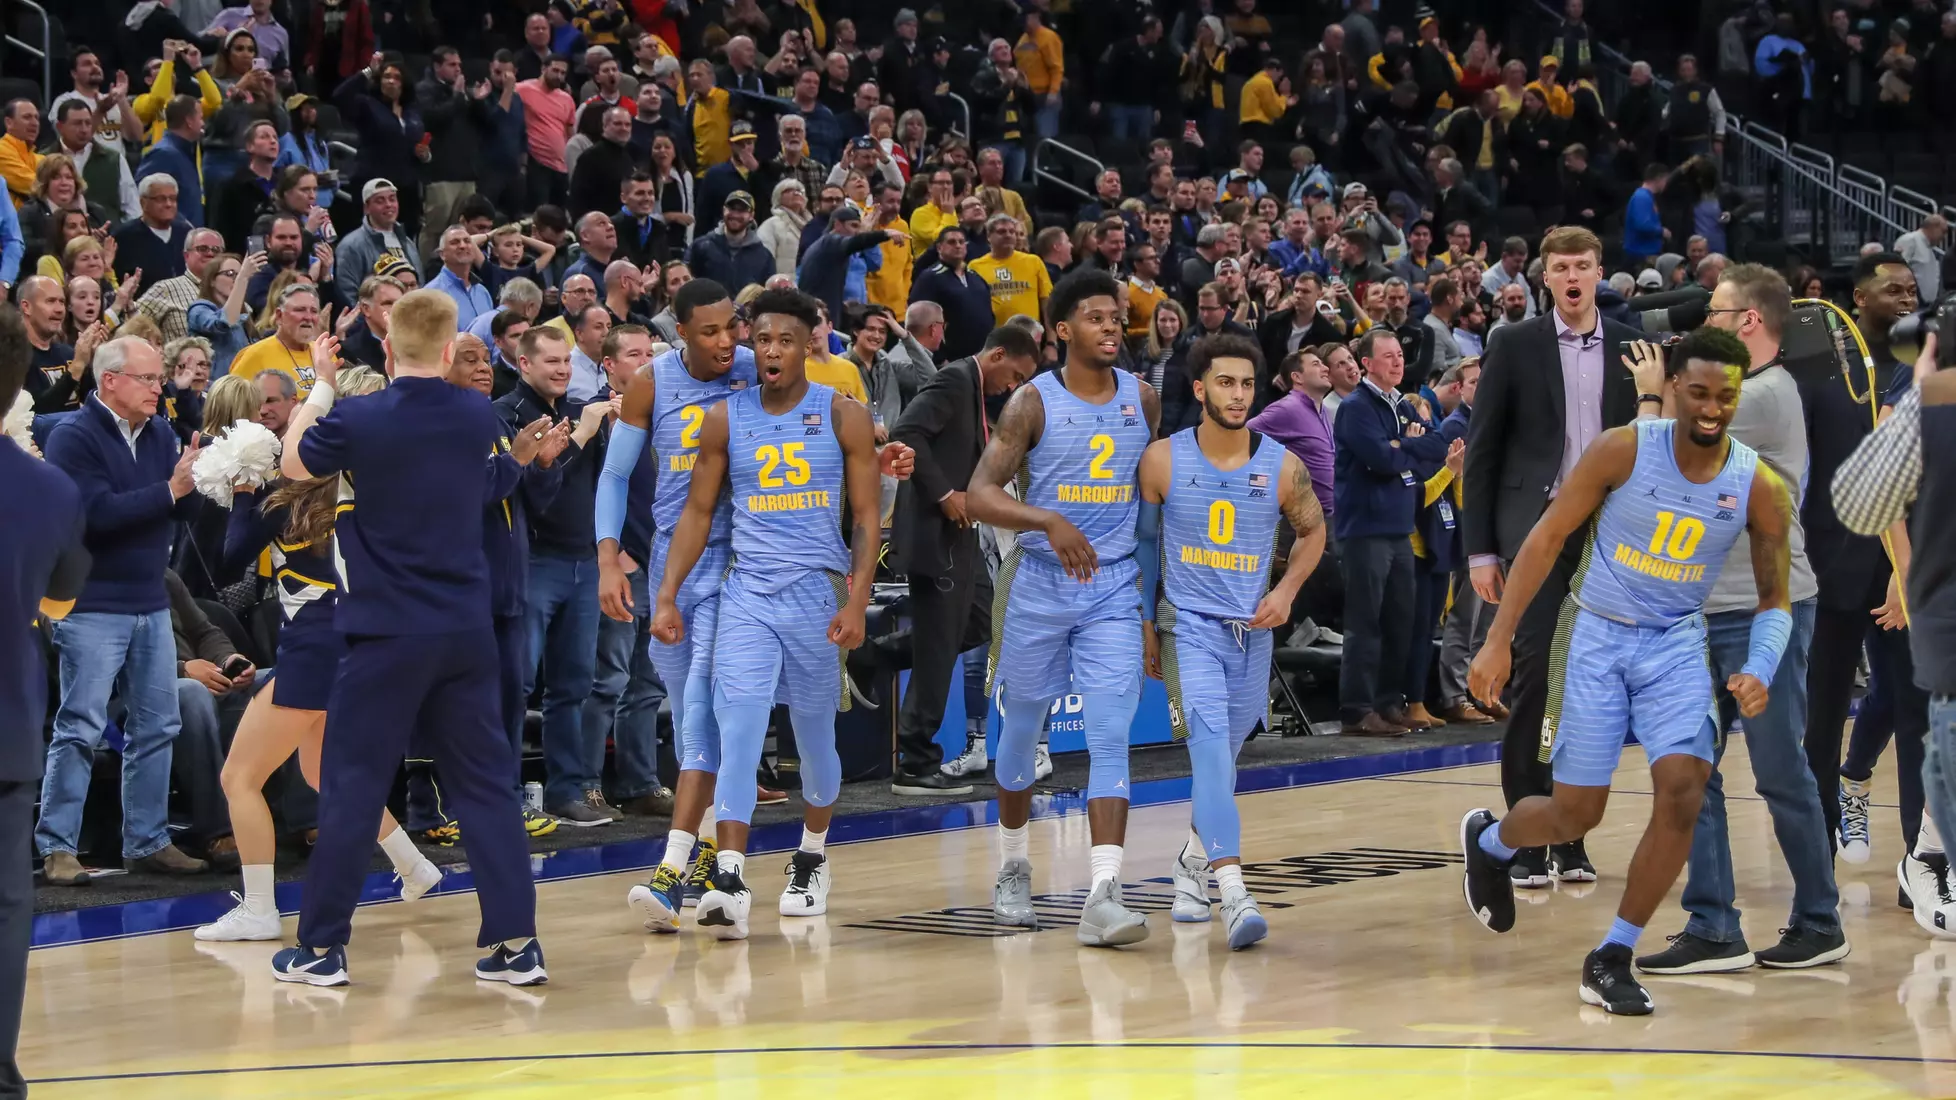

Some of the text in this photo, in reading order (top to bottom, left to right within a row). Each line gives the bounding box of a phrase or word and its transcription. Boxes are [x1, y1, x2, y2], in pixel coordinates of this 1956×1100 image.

[680, 404, 705, 449] 2
[755, 442, 812, 488] 25
[1089, 434, 1115, 479] 2
[748, 490, 831, 512] MARQUETTE
[1058, 484, 1134, 503] MARQUETT
[1207, 500, 1236, 545] 0
[1648, 511, 1706, 561] 10
[1613, 543, 1707, 582] MARQUETTE
[1051, 720, 1085, 732] FFICES
